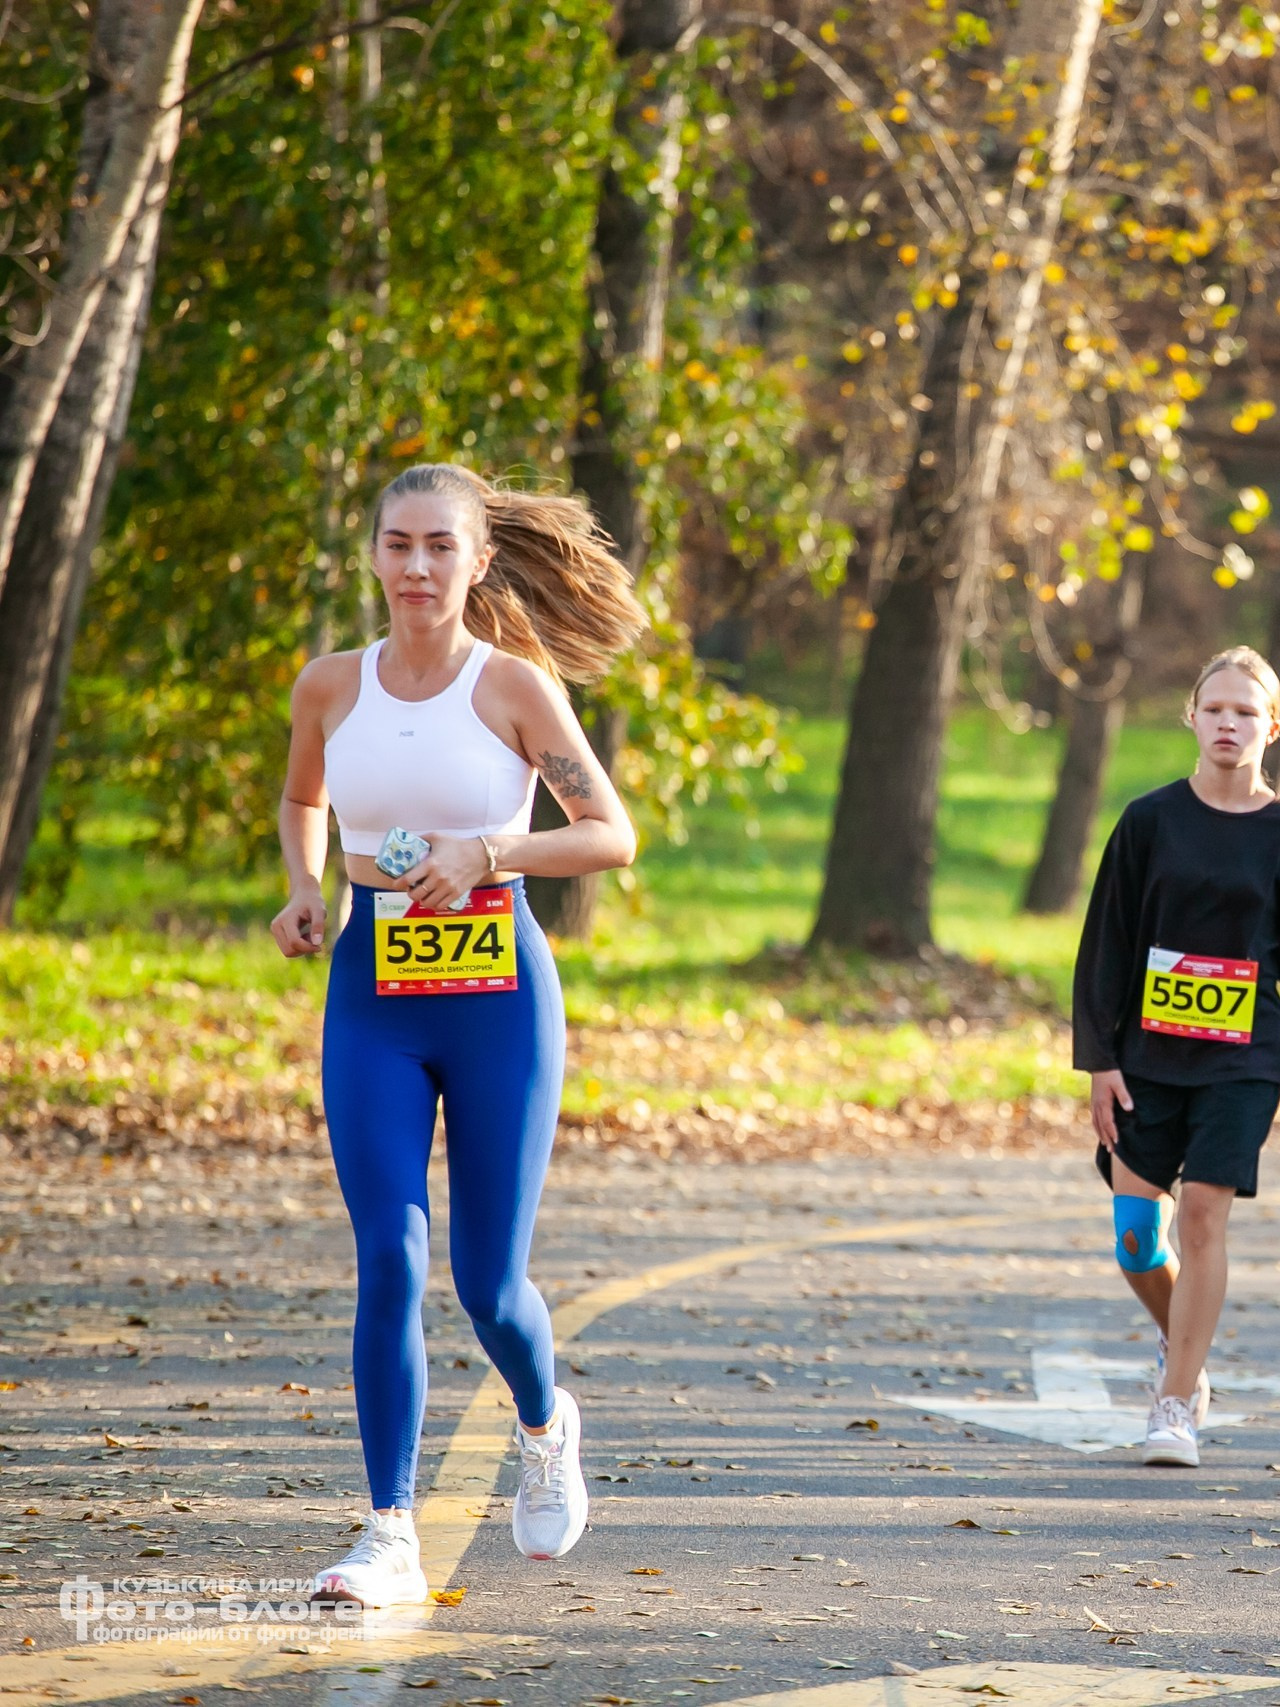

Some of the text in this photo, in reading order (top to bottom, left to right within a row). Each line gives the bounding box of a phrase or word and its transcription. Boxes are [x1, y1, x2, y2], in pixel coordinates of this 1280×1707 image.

[386, 922, 504, 964] 5374
[397, 964, 493, 974] СМИРНОВА ВИКТОРИЯ
[1151, 976, 1249, 1016] 5507
